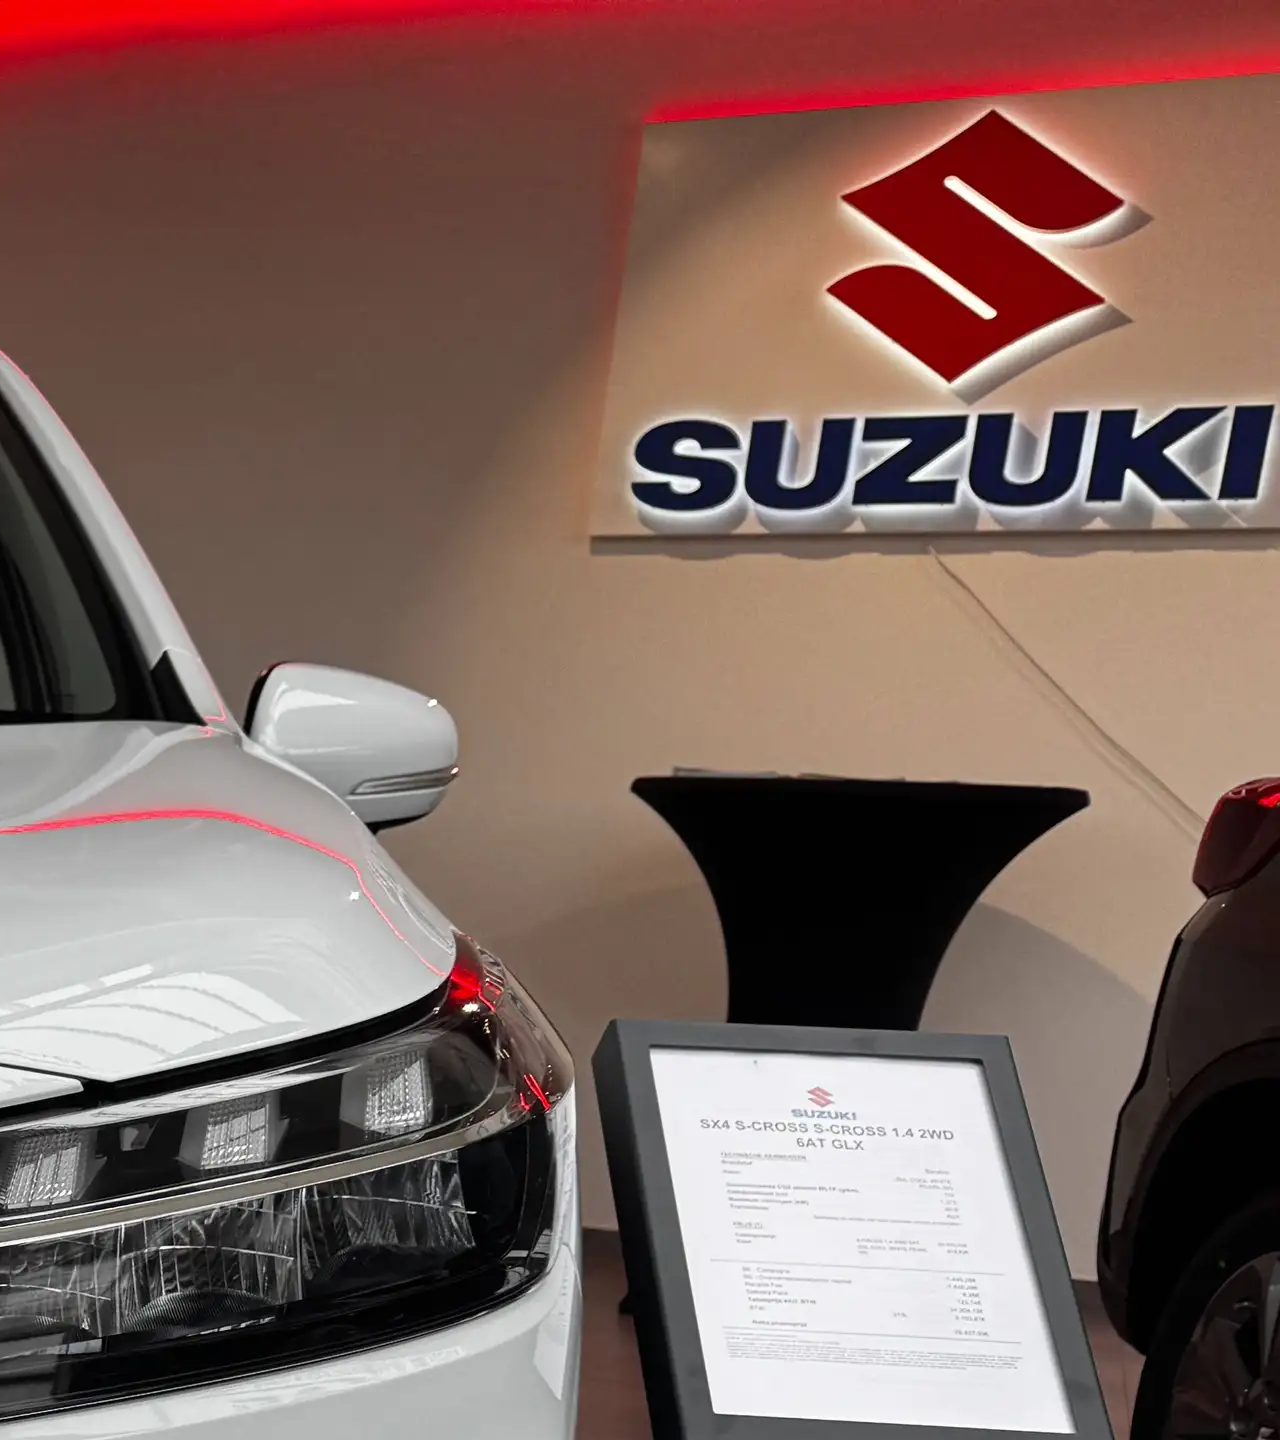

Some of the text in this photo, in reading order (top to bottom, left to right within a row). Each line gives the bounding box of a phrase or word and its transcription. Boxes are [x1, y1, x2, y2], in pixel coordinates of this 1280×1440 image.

[631, 404, 1275, 511] SUZUKI
[791, 1108, 857, 1121] SUZUKI
[700, 1118, 955, 1141] SX4 S-CROSS S-CROSS 1.4 2WD
[796, 1137, 865, 1151] 6AT GLX
